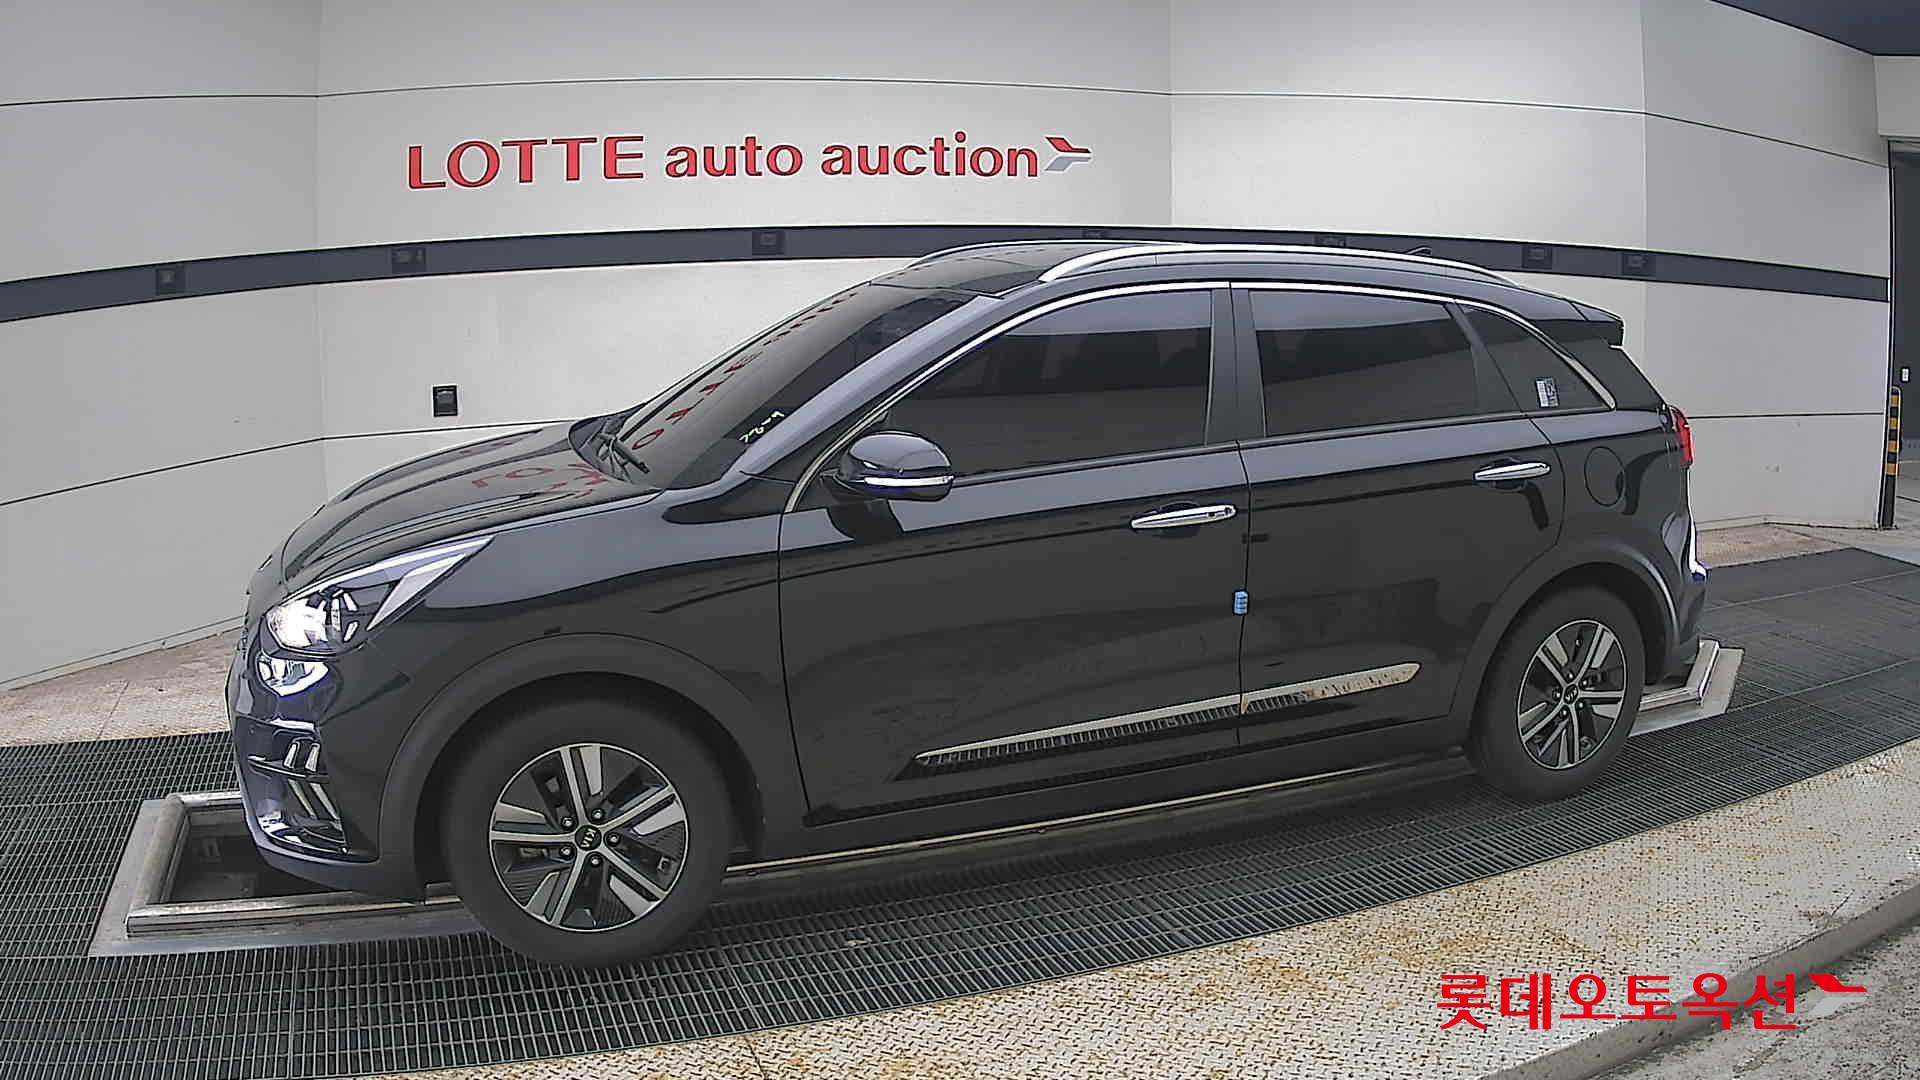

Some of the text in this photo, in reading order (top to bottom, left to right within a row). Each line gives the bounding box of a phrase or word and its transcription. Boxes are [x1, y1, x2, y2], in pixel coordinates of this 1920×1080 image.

[407, 132, 1040, 190] LOTTE auto auction
